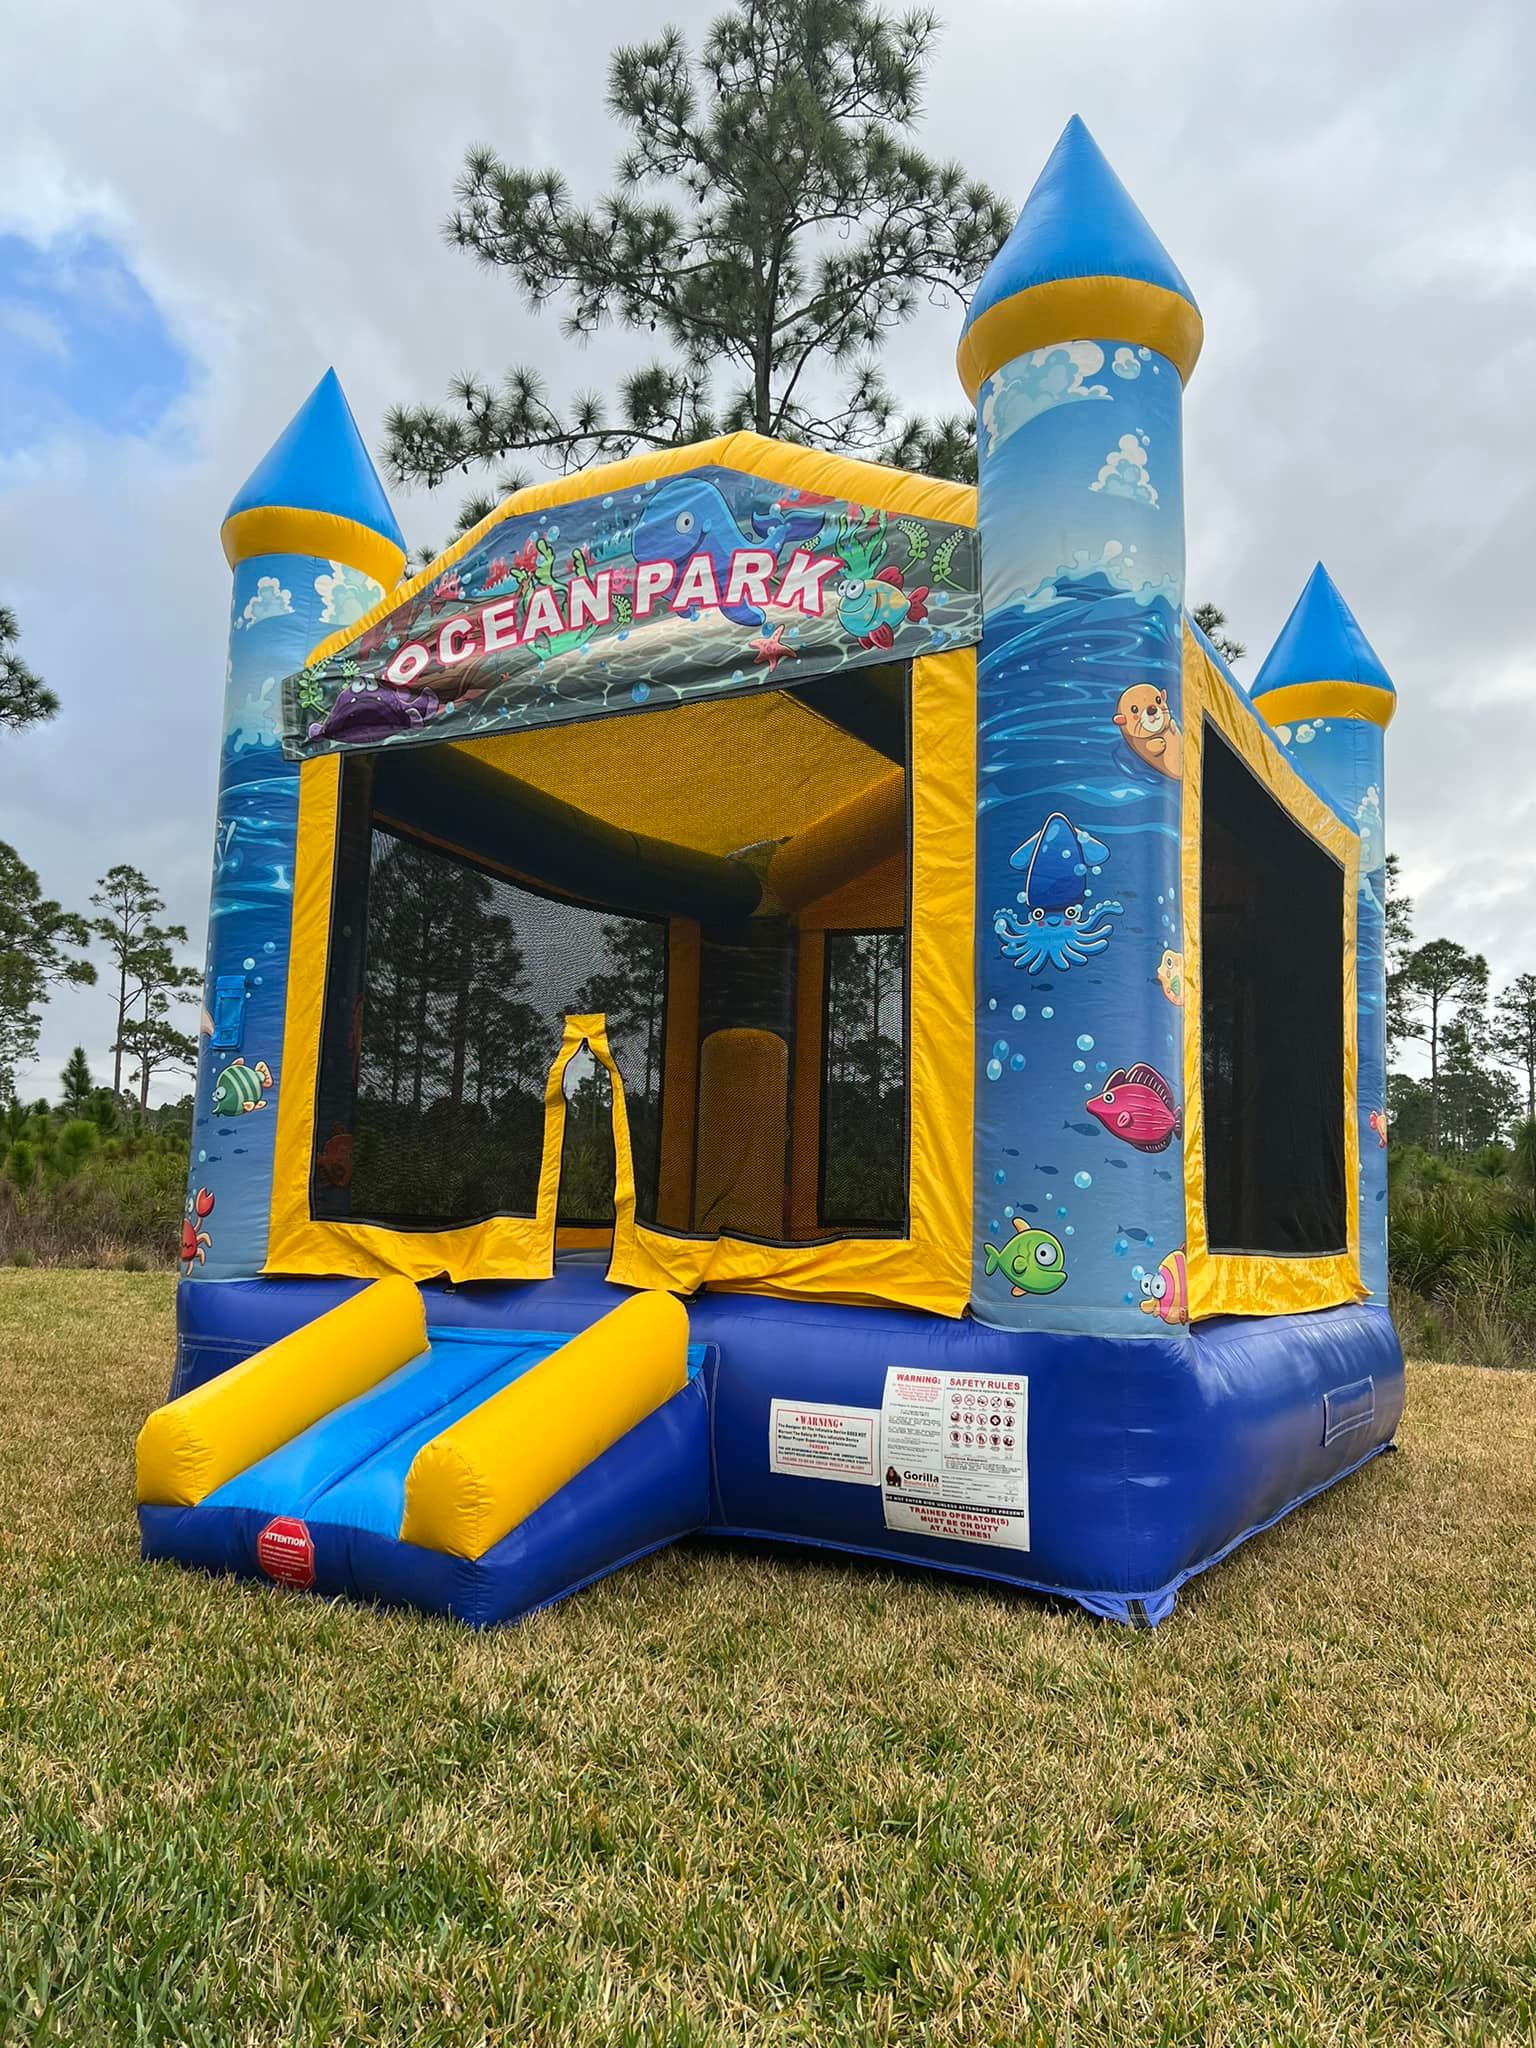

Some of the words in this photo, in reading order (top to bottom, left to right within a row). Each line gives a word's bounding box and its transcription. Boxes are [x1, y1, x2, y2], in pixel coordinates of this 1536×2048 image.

[384, 572, 612, 690] OCEAN
[634, 549, 843, 618] PARK
[896, 1373, 941, 1384] WARNING:
[949, 1378, 985, 1388] SAFETY
[988, 1380, 1020, 1390] RULES
[800, 1415, 838, 1428] WARNING
[903, 1470, 939, 1483] Gorilla
[909, 1506, 947, 1517] TRAINED
[949, 1511, 1009, 1526] OPERATOR(S)
[920, 1515, 944, 1525] MUST
[959, 1521, 973, 1529] ON
[974, 1523, 999, 1532] DUTY
[265, 1531, 305, 1547] ATTENTION
[930, 1524, 941, 1532] AT
[942, 1526, 958, 1534] ALL
[960, 1529, 991, 1540] TIMES!
